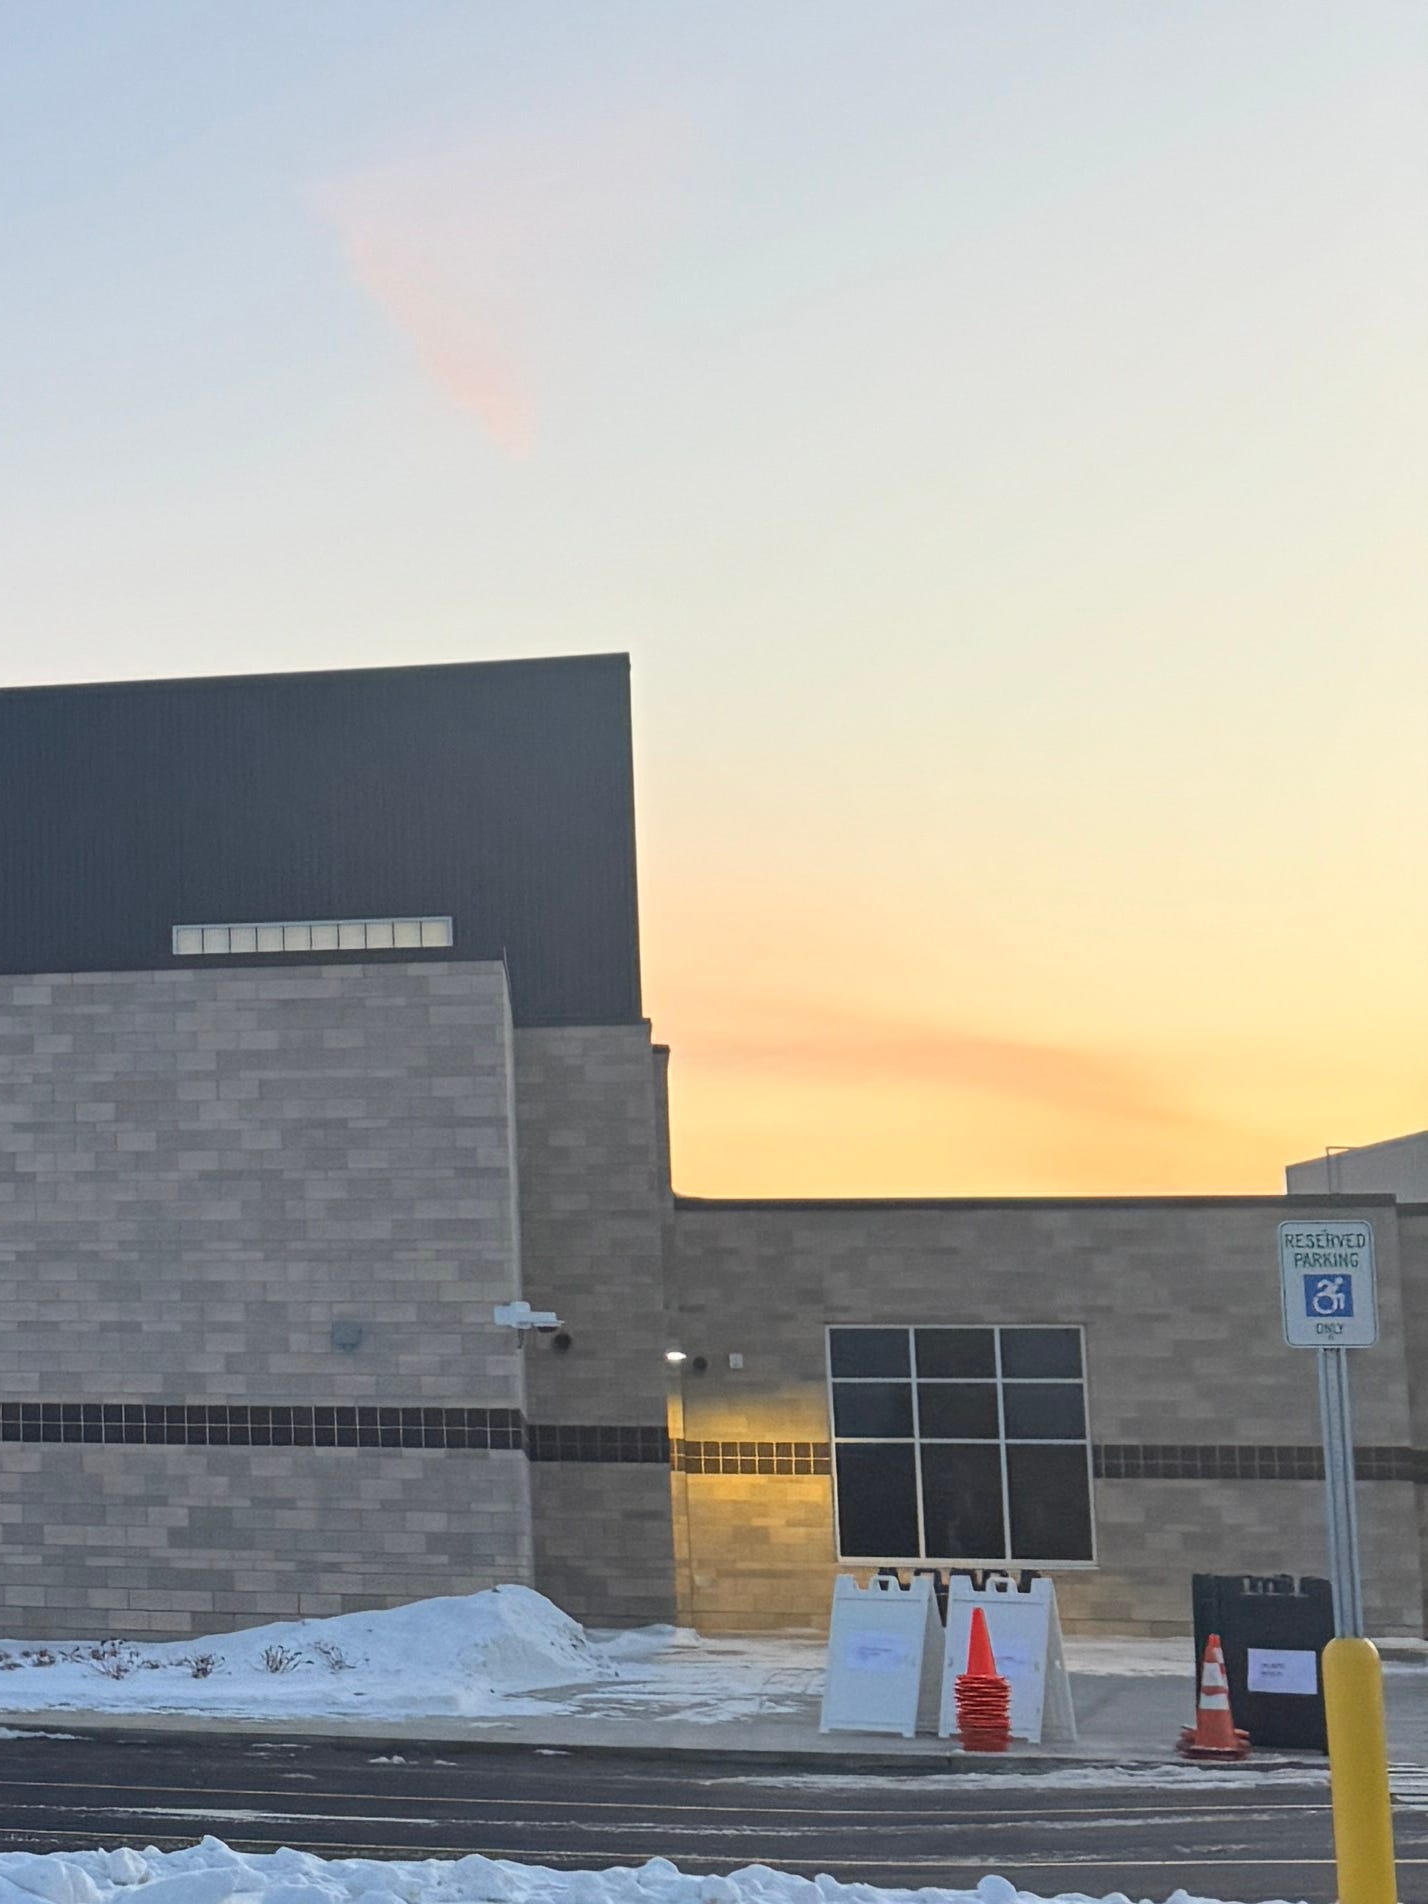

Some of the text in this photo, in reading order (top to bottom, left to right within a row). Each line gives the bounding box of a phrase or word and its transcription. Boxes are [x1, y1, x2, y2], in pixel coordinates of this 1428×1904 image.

[1284, 1233, 1366, 1249] RESERVED
[1294, 1252, 1359, 1268] PARKING
[1316, 1322, 1344, 1334] ONLY
